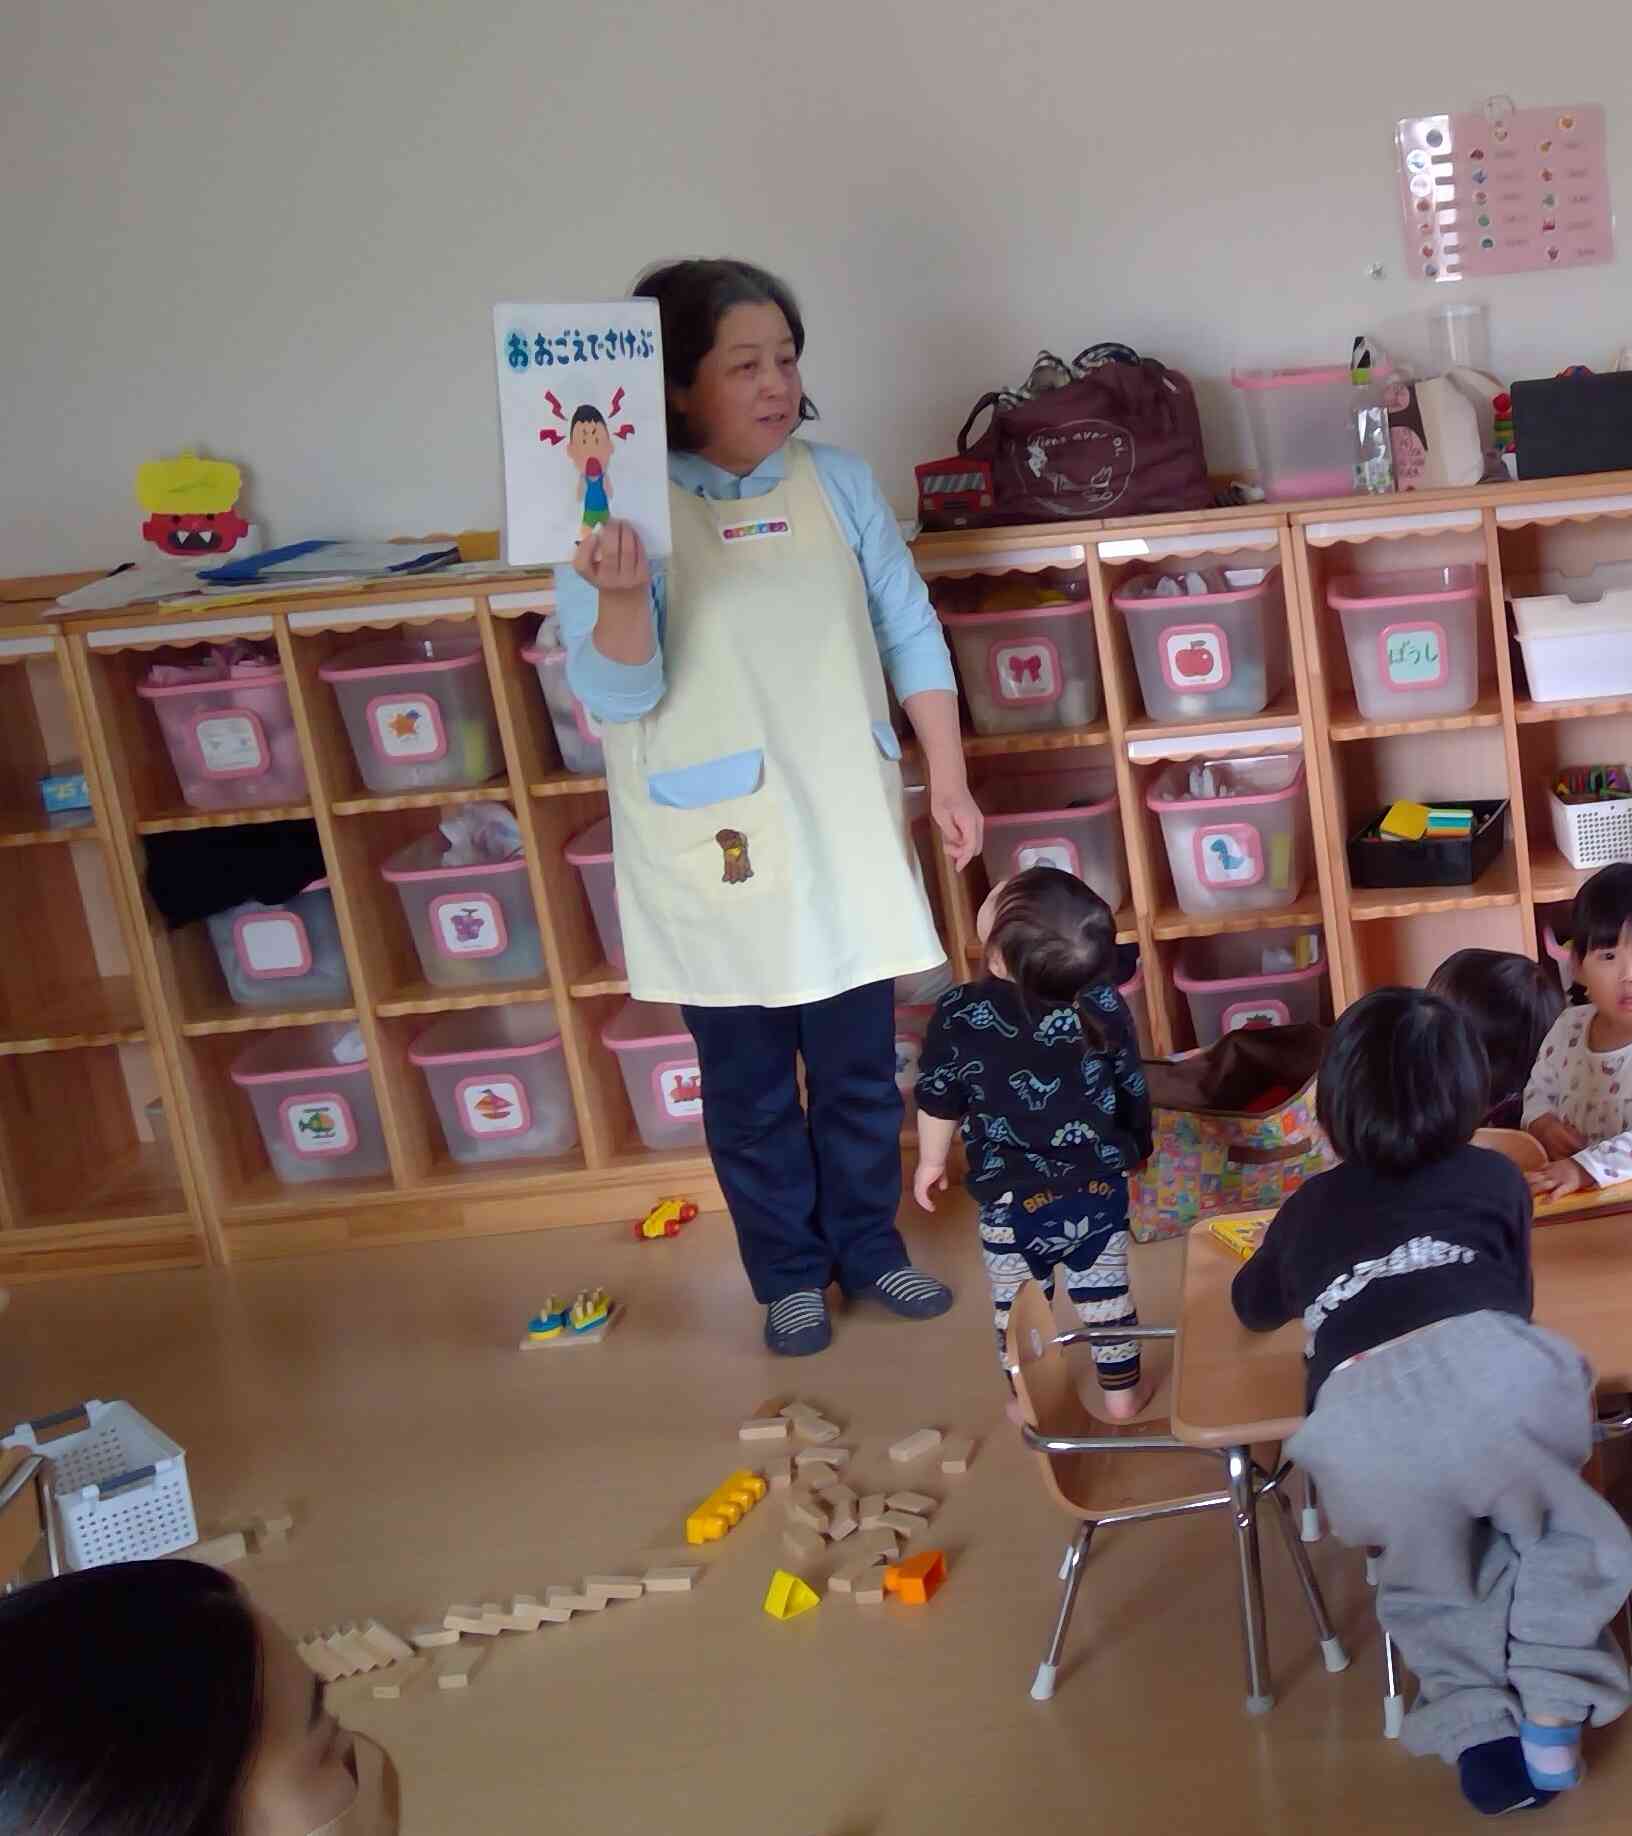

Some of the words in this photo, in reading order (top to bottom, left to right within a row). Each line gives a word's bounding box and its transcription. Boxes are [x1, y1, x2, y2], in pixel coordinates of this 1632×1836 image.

[507, 328, 654, 368] おおごえでさけぶ
